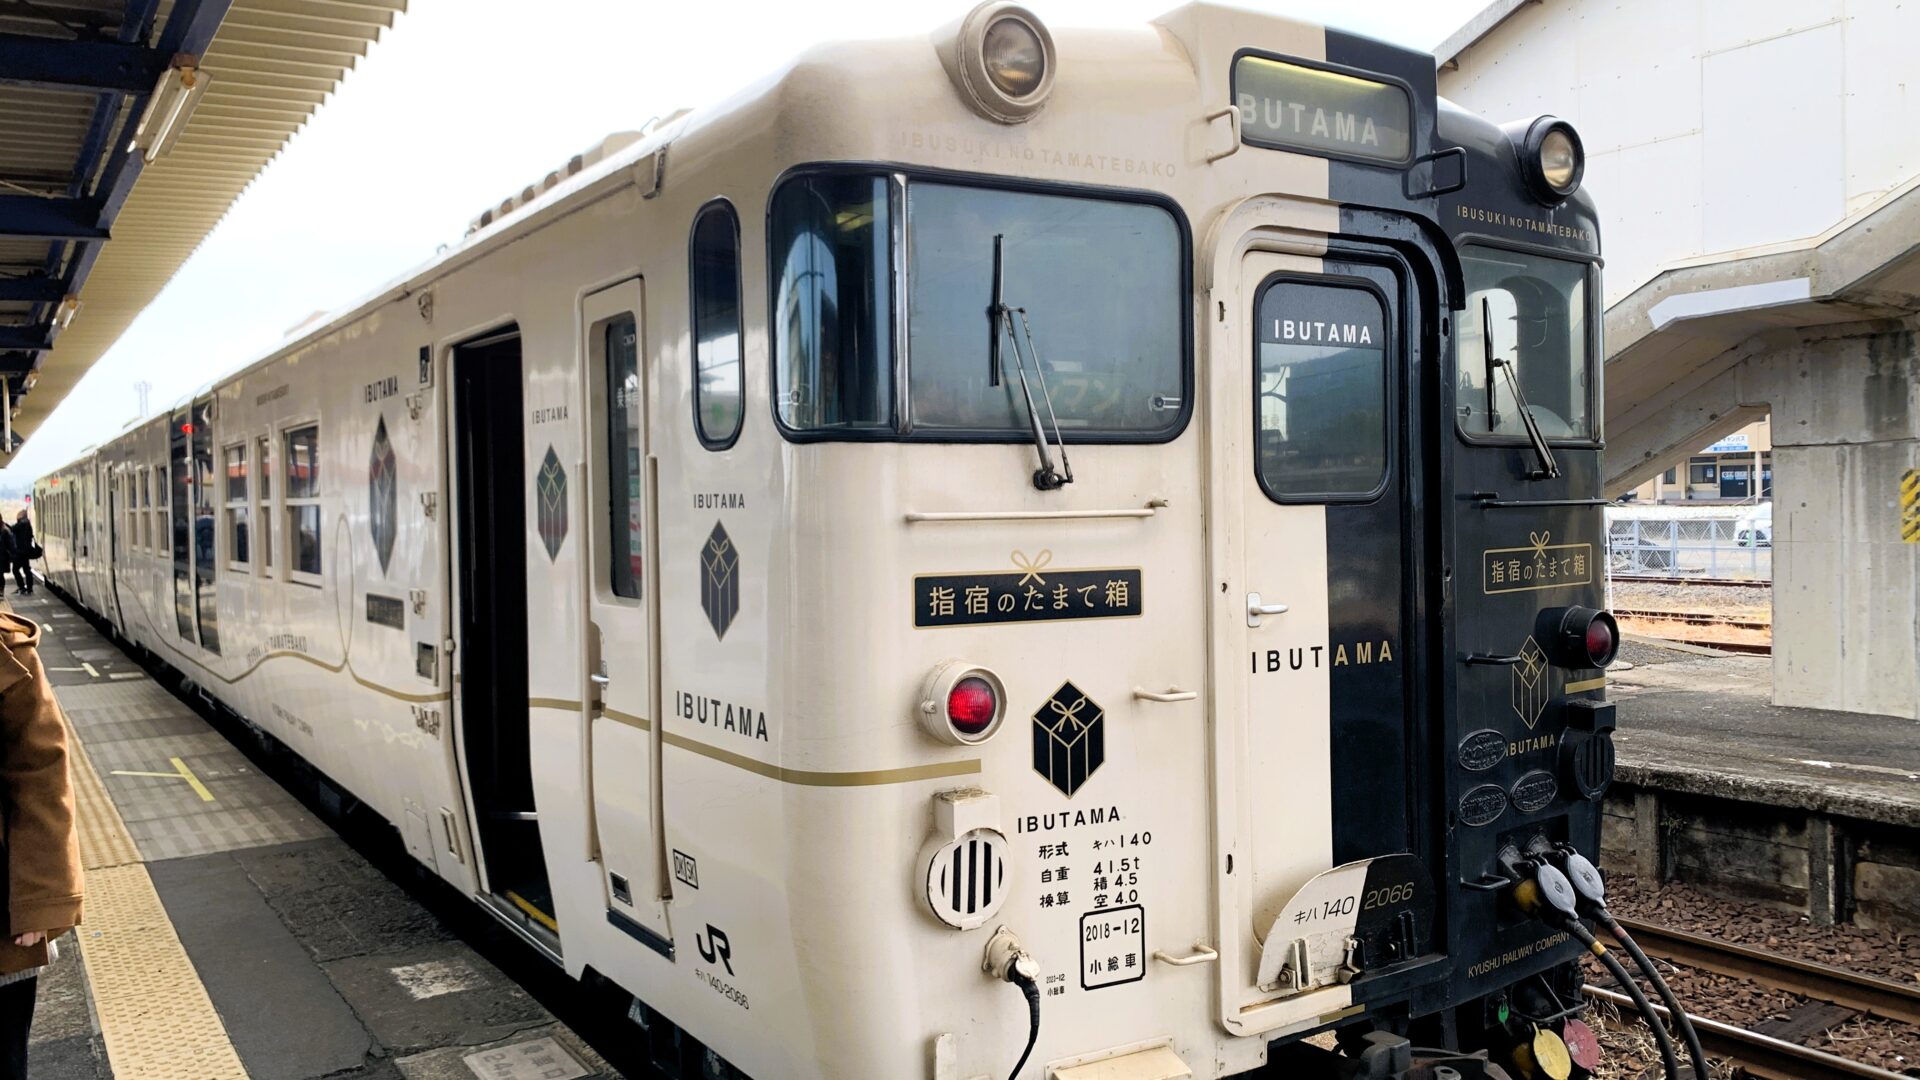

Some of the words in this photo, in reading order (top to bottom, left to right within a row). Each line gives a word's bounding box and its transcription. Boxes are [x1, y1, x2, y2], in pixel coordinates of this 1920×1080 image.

[902, 132, 999, 158] IBUSUKI
[1041, 150, 1176, 177] TAMATEBAKO
[1457, 205, 1506, 225] IBUSUKI
[1510, 216, 1522, 228] NO
[1525, 218, 1592, 242] TAMATEBAKO
[1274, 319, 1371, 344] IBUTAMA
[365, 376, 398, 404] IBUTAMA
[532, 406, 568, 424] IBUTAMA
[693, 493, 745, 509] IBUTAMA
[1492, 554, 1585, 583] 指宿のたまて箱
[929, 579, 1129, 617] 指宿のたまて箱
[1252, 640, 1392, 674] IBUTAMA
[677, 690, 768, 742] IBUTAMA
[1505, 734, 1555, 756] IBUTAMA
[1018, 806, 1120, 834] IBUTAMA
[1039, 841, 1069, 860] 形式
[1041, 866, 1070, 883] 自重
[1039, 891, 1071, 908] 換算
[1364, 882, 1415, 910] 2066
[1085, 918, 1140, 942] 2018-12
[696, 923, 735, 976] JR
[1468, 956, 1500, 978] KYUSHU
[1502, 943, 1534, 965] RAILWAY
